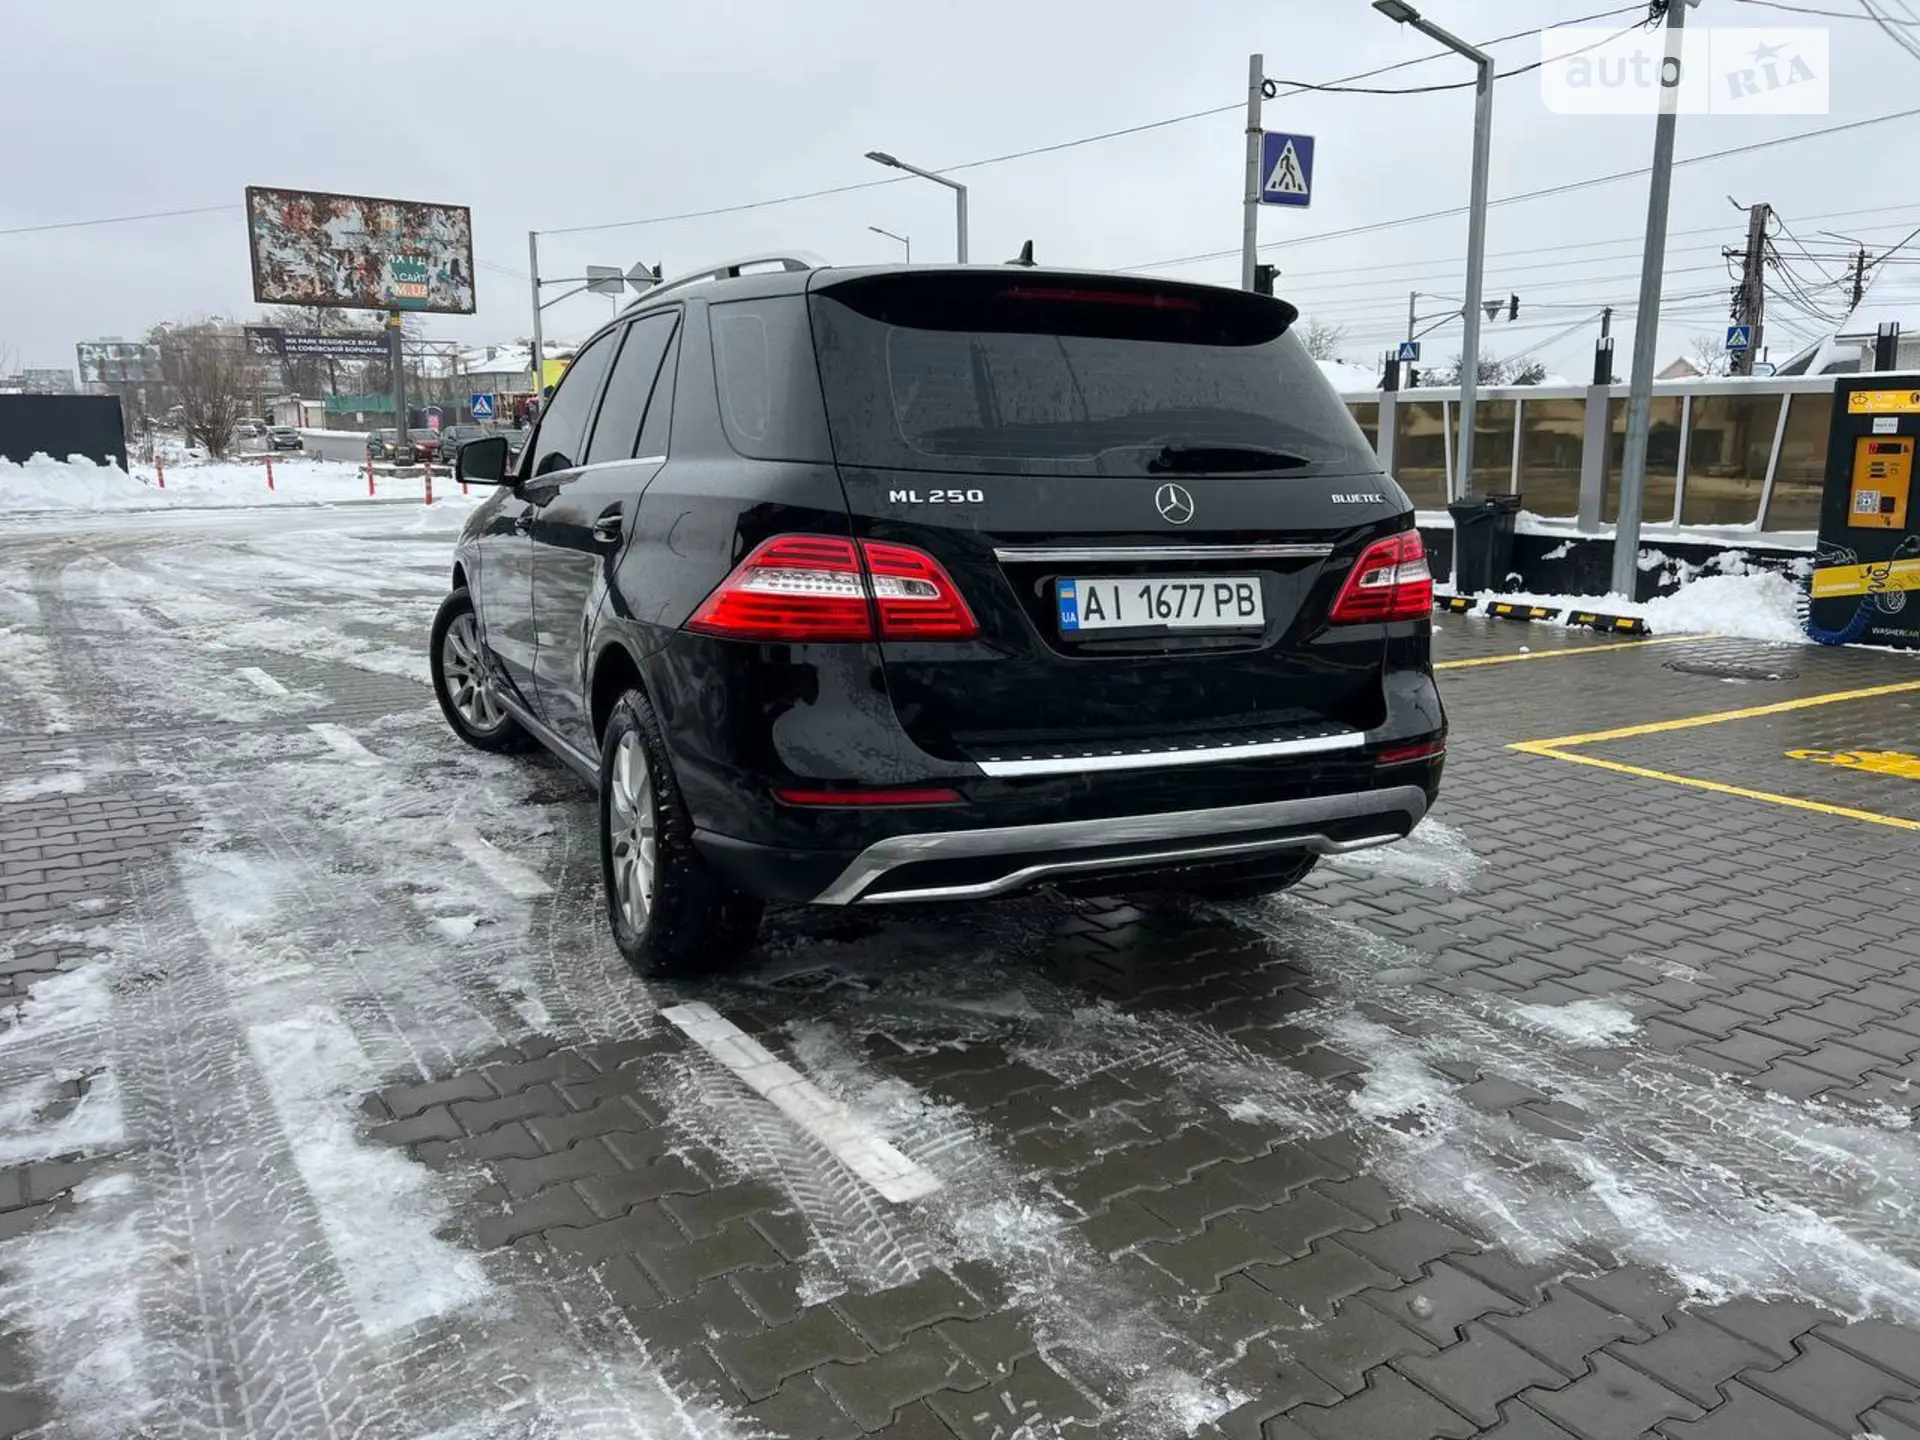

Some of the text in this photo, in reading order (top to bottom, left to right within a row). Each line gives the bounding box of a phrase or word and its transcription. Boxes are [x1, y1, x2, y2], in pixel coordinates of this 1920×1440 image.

[889, 489, 984, 503] ML 250
[1331, 493, 1384, 503] BLUETEC
[1138, 584, 1205, 620] 1677
[1061, 611, 1077, 624] UA
